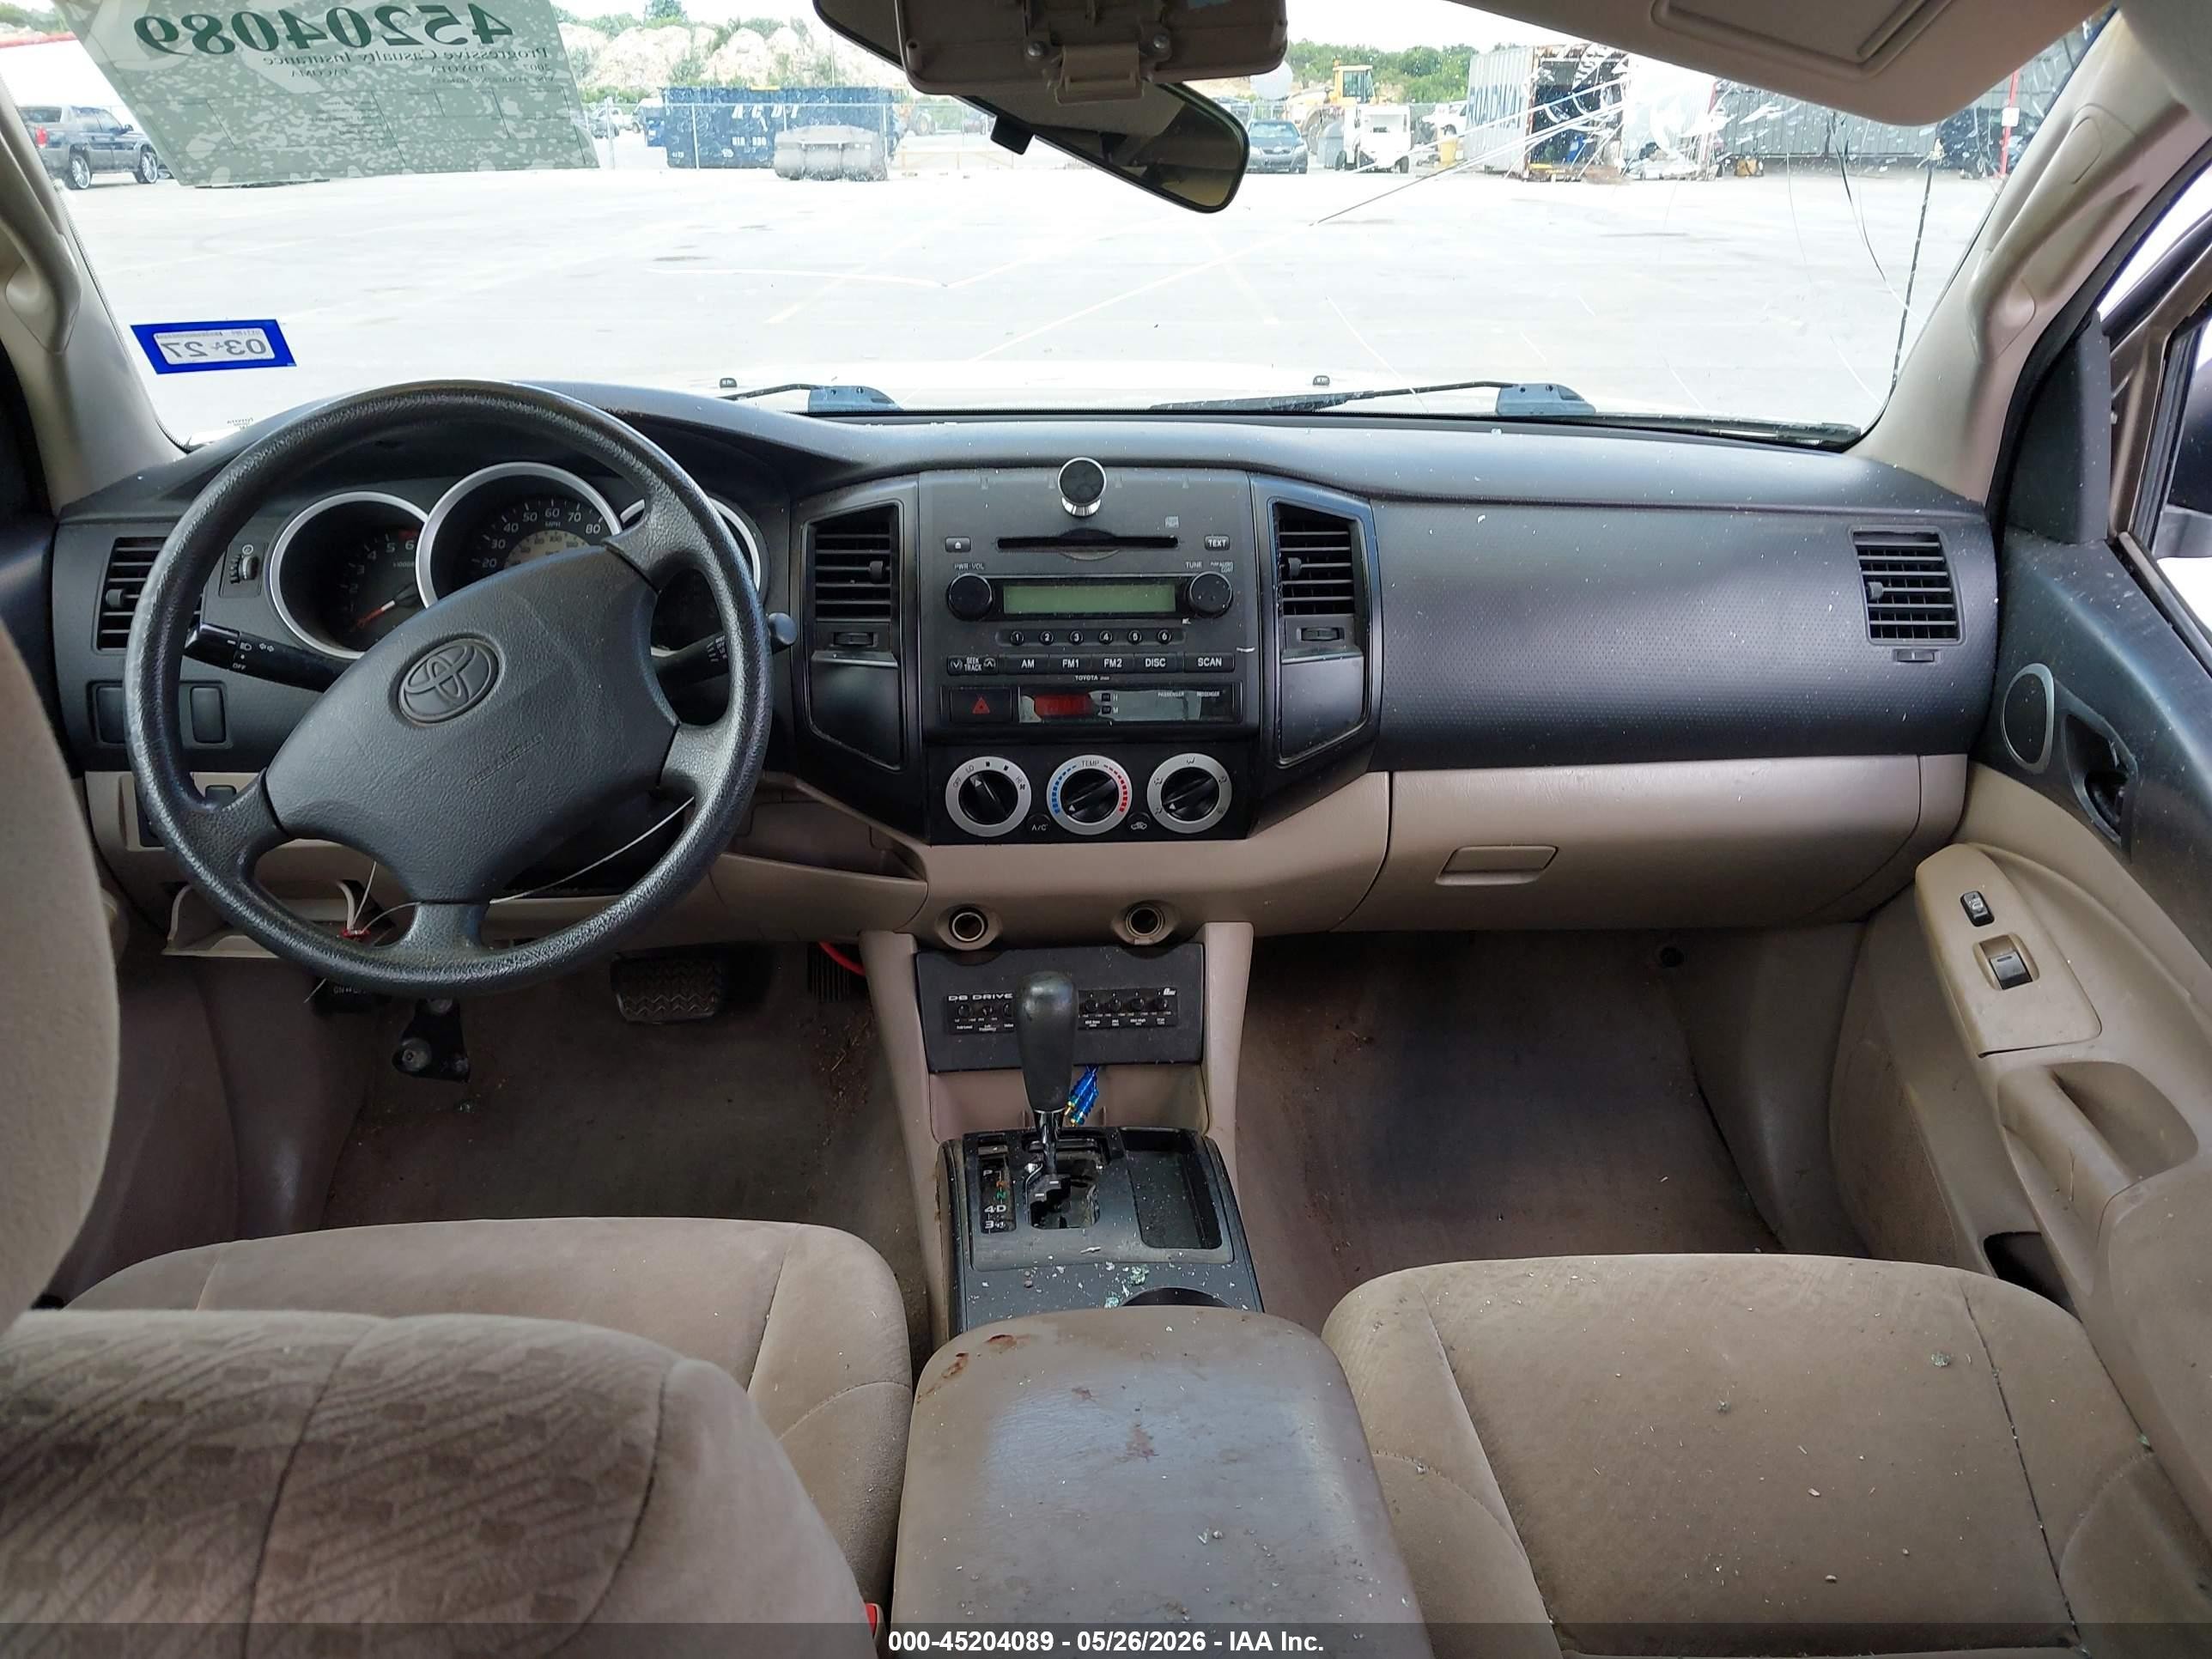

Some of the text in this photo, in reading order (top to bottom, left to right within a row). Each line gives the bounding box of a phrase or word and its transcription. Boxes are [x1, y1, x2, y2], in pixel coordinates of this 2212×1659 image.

[523, 512, 538, 522] 50
[544, 507, 560, 518] 60
[568, 512, 582, 523] 70
[503, 523, 519, 533] 40
[585, 524, 601, 534] 80
[386, 543, 395, 553] 5
[404, 540, 414, 550] 6
[490, 539, 506, 550] 30
[1207, 538, 1227, 548] TEXT
[482, 558, 497, 568] 20
[1043, 632, 1050, 641] 2
[1073, 632, 1079, 641] 3
[1102, 631, 1109, 641] 4
[1132, 631, 1139, 640] 5
[1161, 631, 1168, 640] 6
[1021, 659, 1036, 668] AM
[1062, 659, 1079, 668] FM1
[1104, 659, 1122, 668] FM2
[1145, 658, 1166, 667] DISC
[1198, 657, 1222, 667] SCAN
[996, 1191, 1006, 1200] N
[985, 1220, 994, 1229] 3
